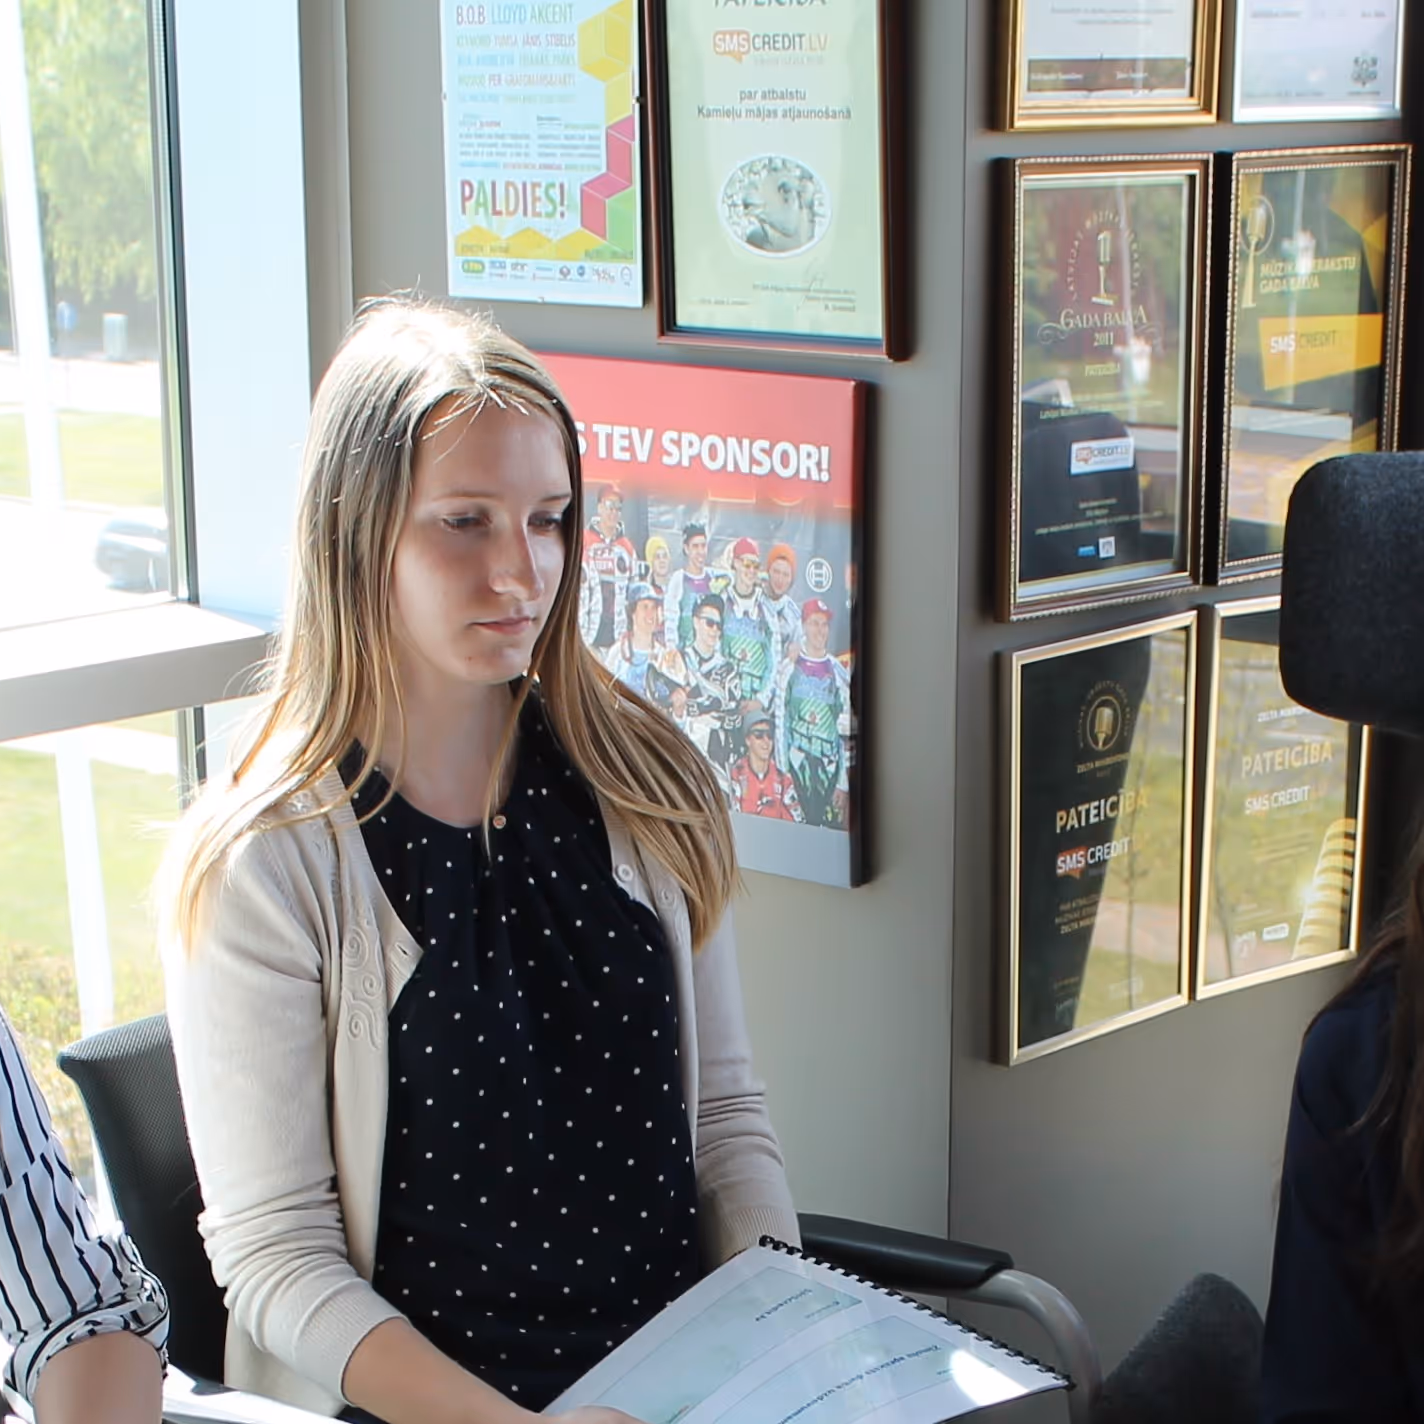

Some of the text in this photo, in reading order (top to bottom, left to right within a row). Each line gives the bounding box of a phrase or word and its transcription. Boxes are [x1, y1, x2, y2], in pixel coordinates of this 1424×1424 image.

[491, 4, 527, 24] LLOYD
[530, 2, 574, 24] AKCENT
[739, 87, 807, 103] par atbalstu
[745, 106, 778, 121] mājas
[782, 105, 852, 121] atjaunošanā
[460, 179, 566, 219] PALDIES!
[1104, 304, 1148, 327] BALA
[592, 423, 654, 463] TEV
[661, 431, 832, 483] SPONSOR!
[1242, 739, 1333, 778] PATEICĪBA
[1056, 788, 1149, 834] PATEICĪBA
[1056, 850, 1085, 874] SMS
